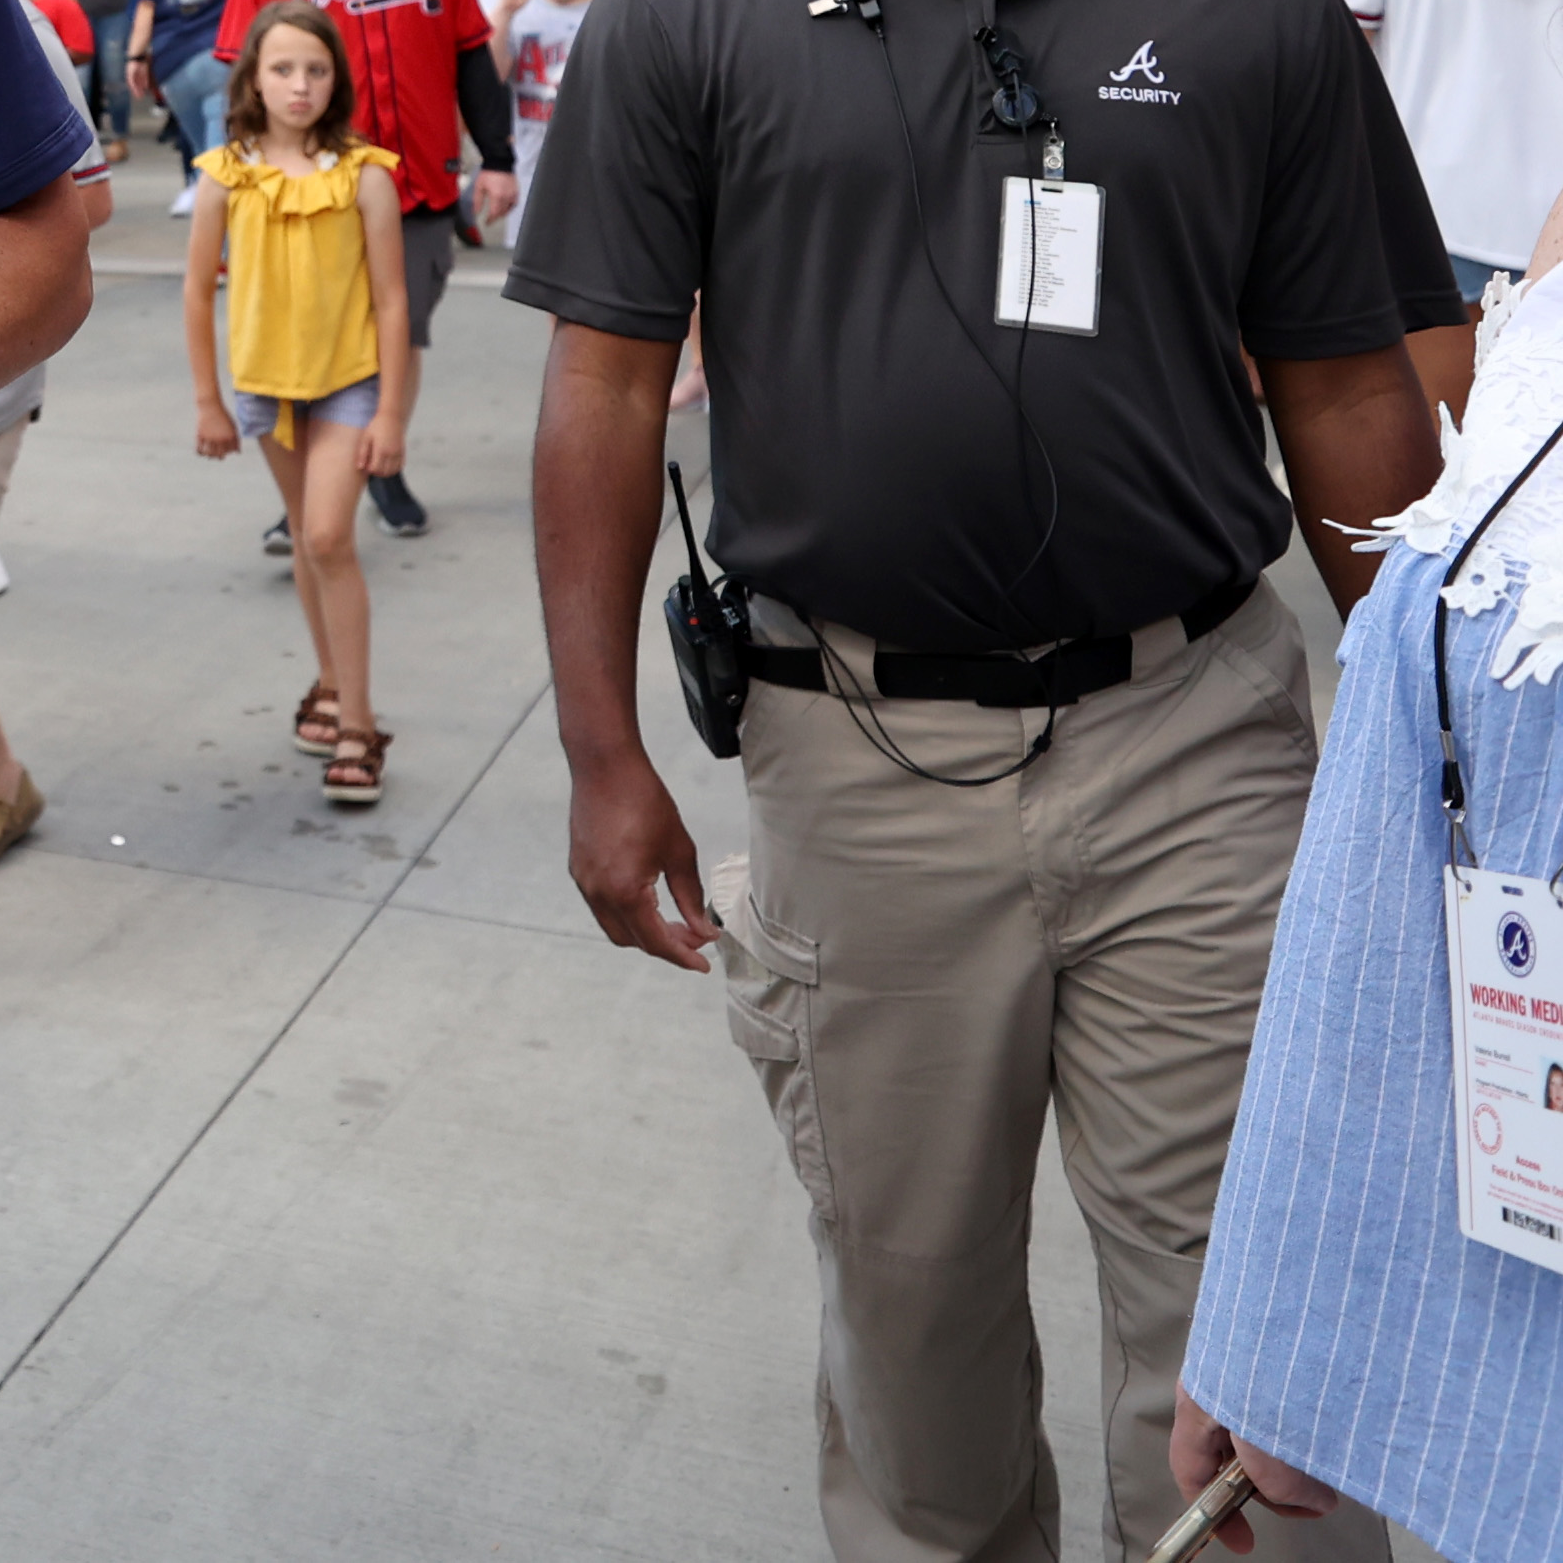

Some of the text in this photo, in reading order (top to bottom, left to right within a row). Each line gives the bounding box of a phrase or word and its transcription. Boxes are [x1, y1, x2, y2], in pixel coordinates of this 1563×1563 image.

[1109, 40, 1165, 84] A
[1098, 86, 1182, 105] SECURITY
[1470, 983, 1527, 1016] WORKING
